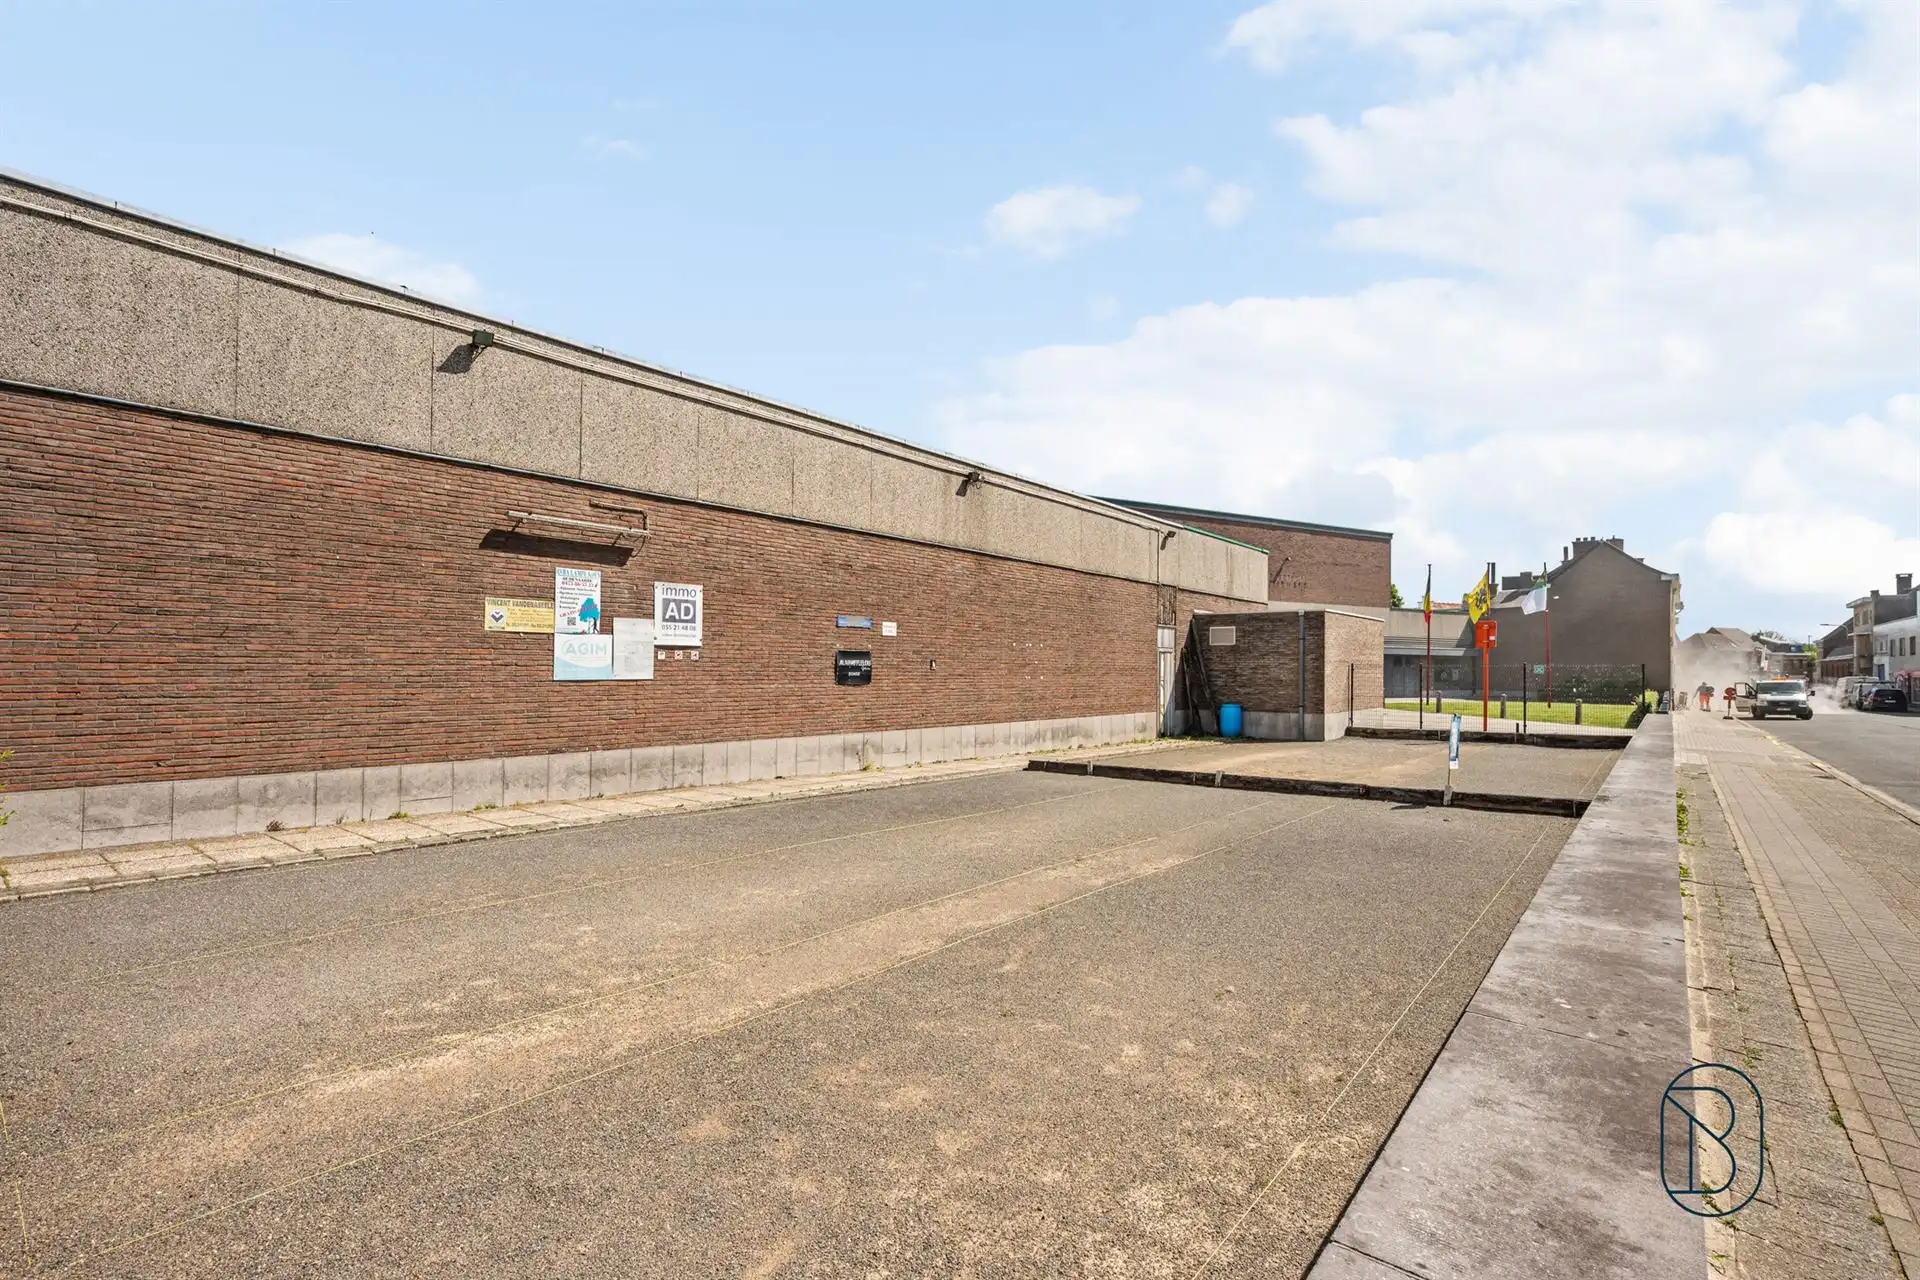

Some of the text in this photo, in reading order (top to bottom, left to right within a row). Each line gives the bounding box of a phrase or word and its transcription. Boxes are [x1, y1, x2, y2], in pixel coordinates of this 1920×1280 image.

[662, 584, 696, 598] immo
[487, 599, 511, 607] VINCENT
[665, 602, 694, 620] AD
[566, 642, 607, 655] AGIM
